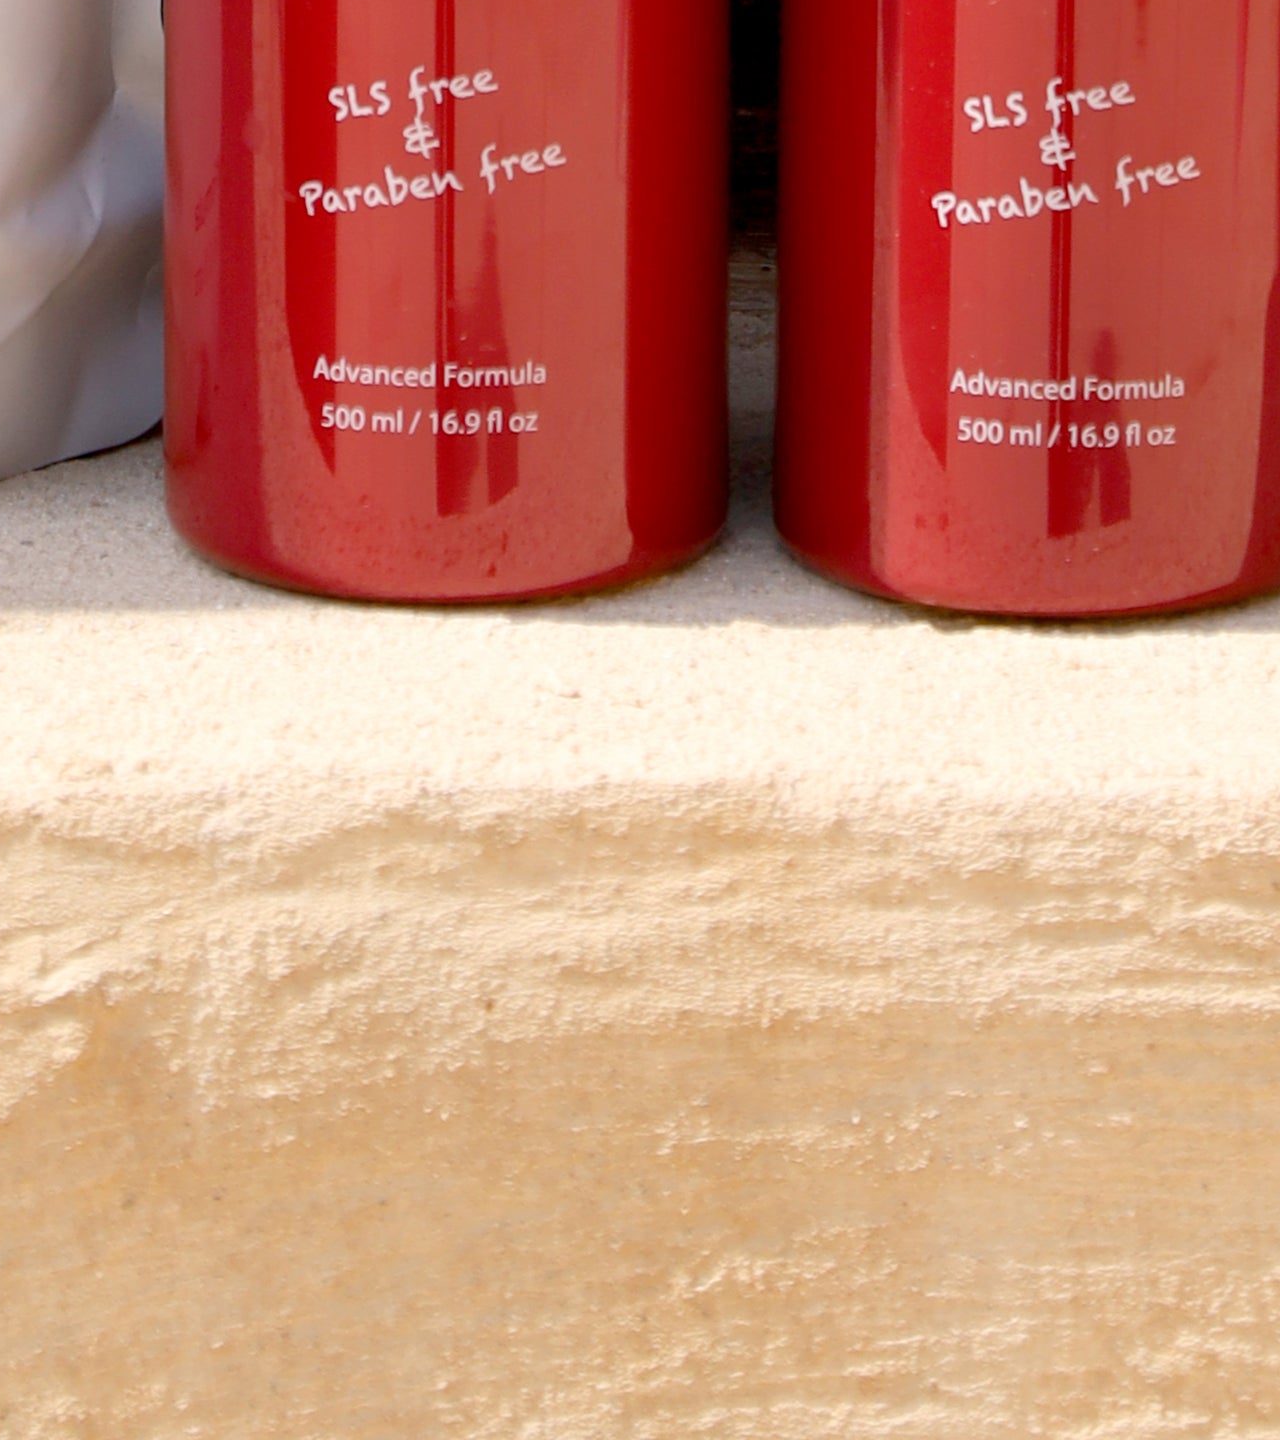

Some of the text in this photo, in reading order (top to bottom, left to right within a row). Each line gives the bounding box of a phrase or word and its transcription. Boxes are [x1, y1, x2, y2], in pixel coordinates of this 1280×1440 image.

[328, 65, 498, 122] SLS free
[964, 77, 1135, 132] SLS free
[403, 118, 439, 159] &
[1039, 130, 1075, 171] &
[299, 141, 567, 216] Paraben free
[932, 153, 1200, 228] Paraben free
[313, 355, 546, 388] Advanced Formula
[950, 368, 1184, 401] Advanced Formula
[321, 405, 366, 432] 500
[371, 409, 403, 433] ml
[428, 410, 481, 435] 16.9
[486, 409, 503, 434] fl
[509, 413, 538, 433] oz
[956, 418, 1004, 444] 500
[1009, 421, 1041, 446] ml
[1067, 423, 1119, 448] 16.9
[1125, 422, 1141, 448] fl
[1147, 426, 1176, 445] oz
